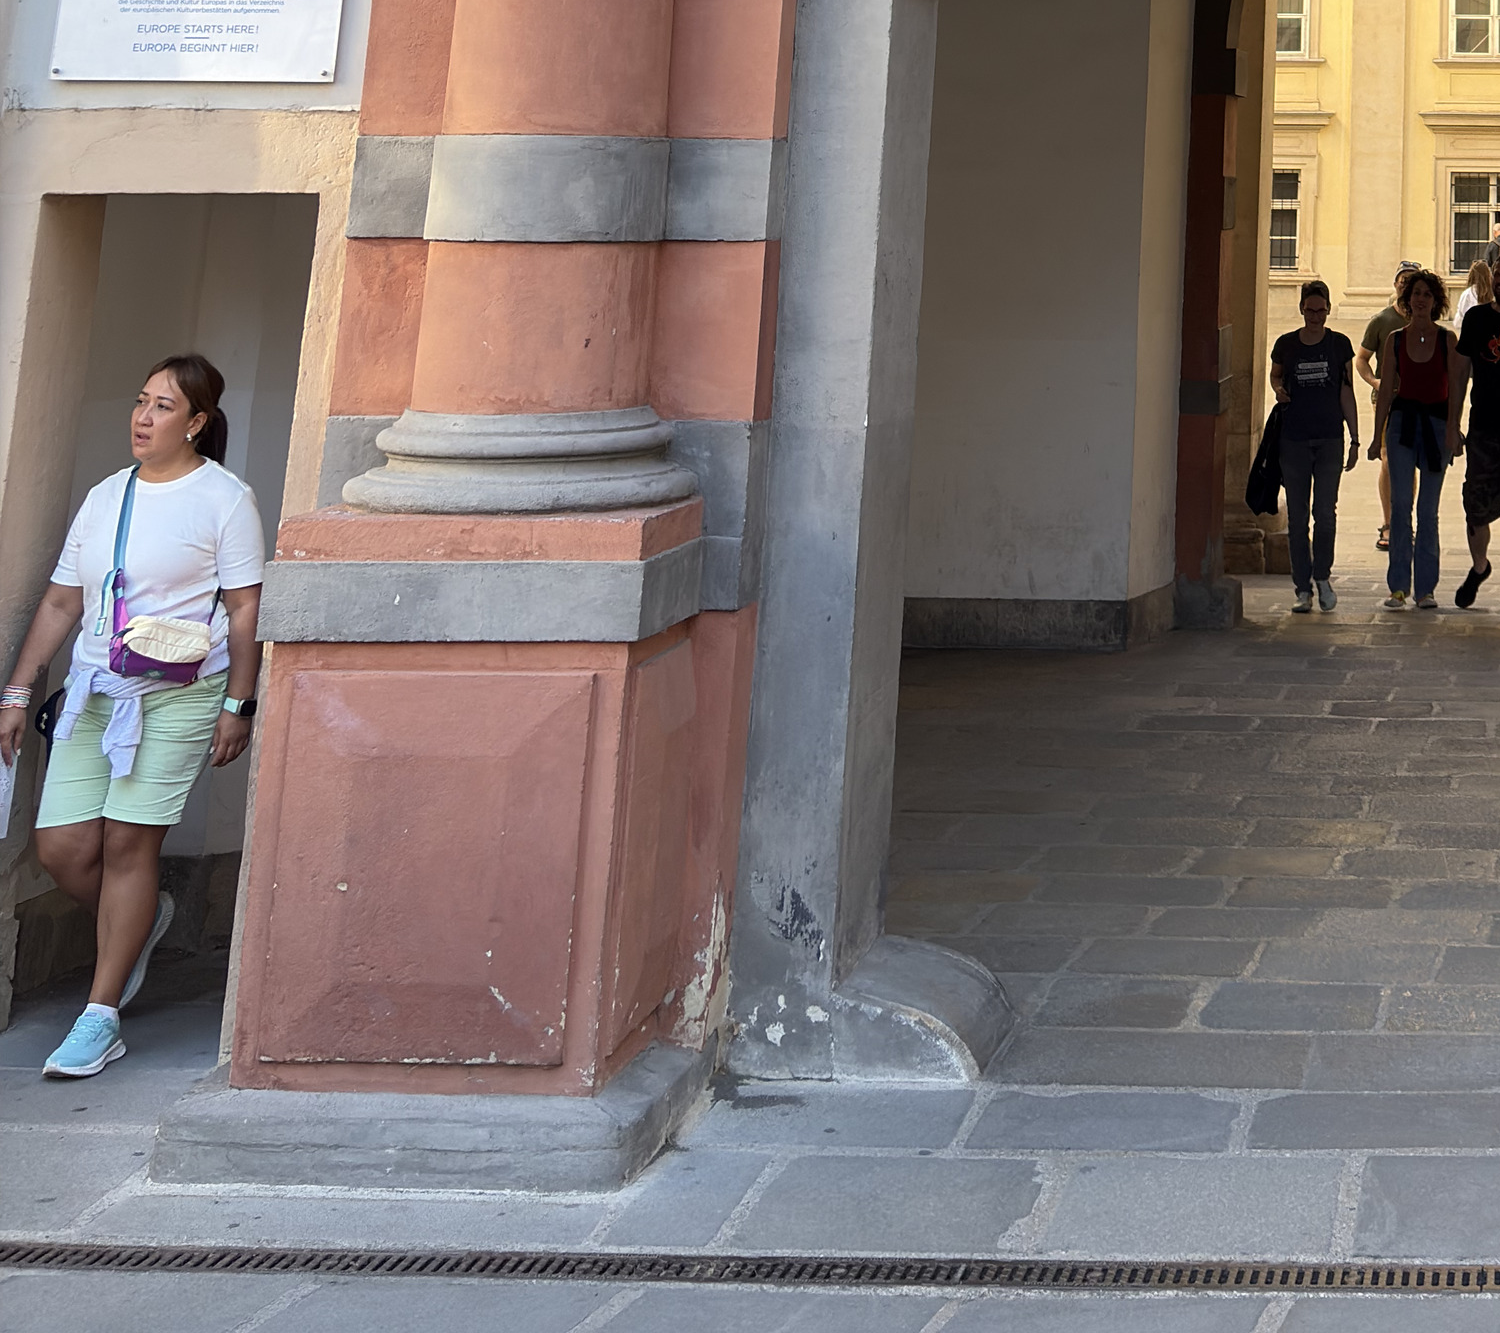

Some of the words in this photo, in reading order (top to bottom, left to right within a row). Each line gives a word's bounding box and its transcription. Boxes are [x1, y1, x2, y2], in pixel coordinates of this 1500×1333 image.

[137, 24, 181, 33] EUROPE
[184, 24, 223, 33] STARTS
[132, 43, 176, 52] EUROPA
[180, 43, 227, 52] BEGINNT
